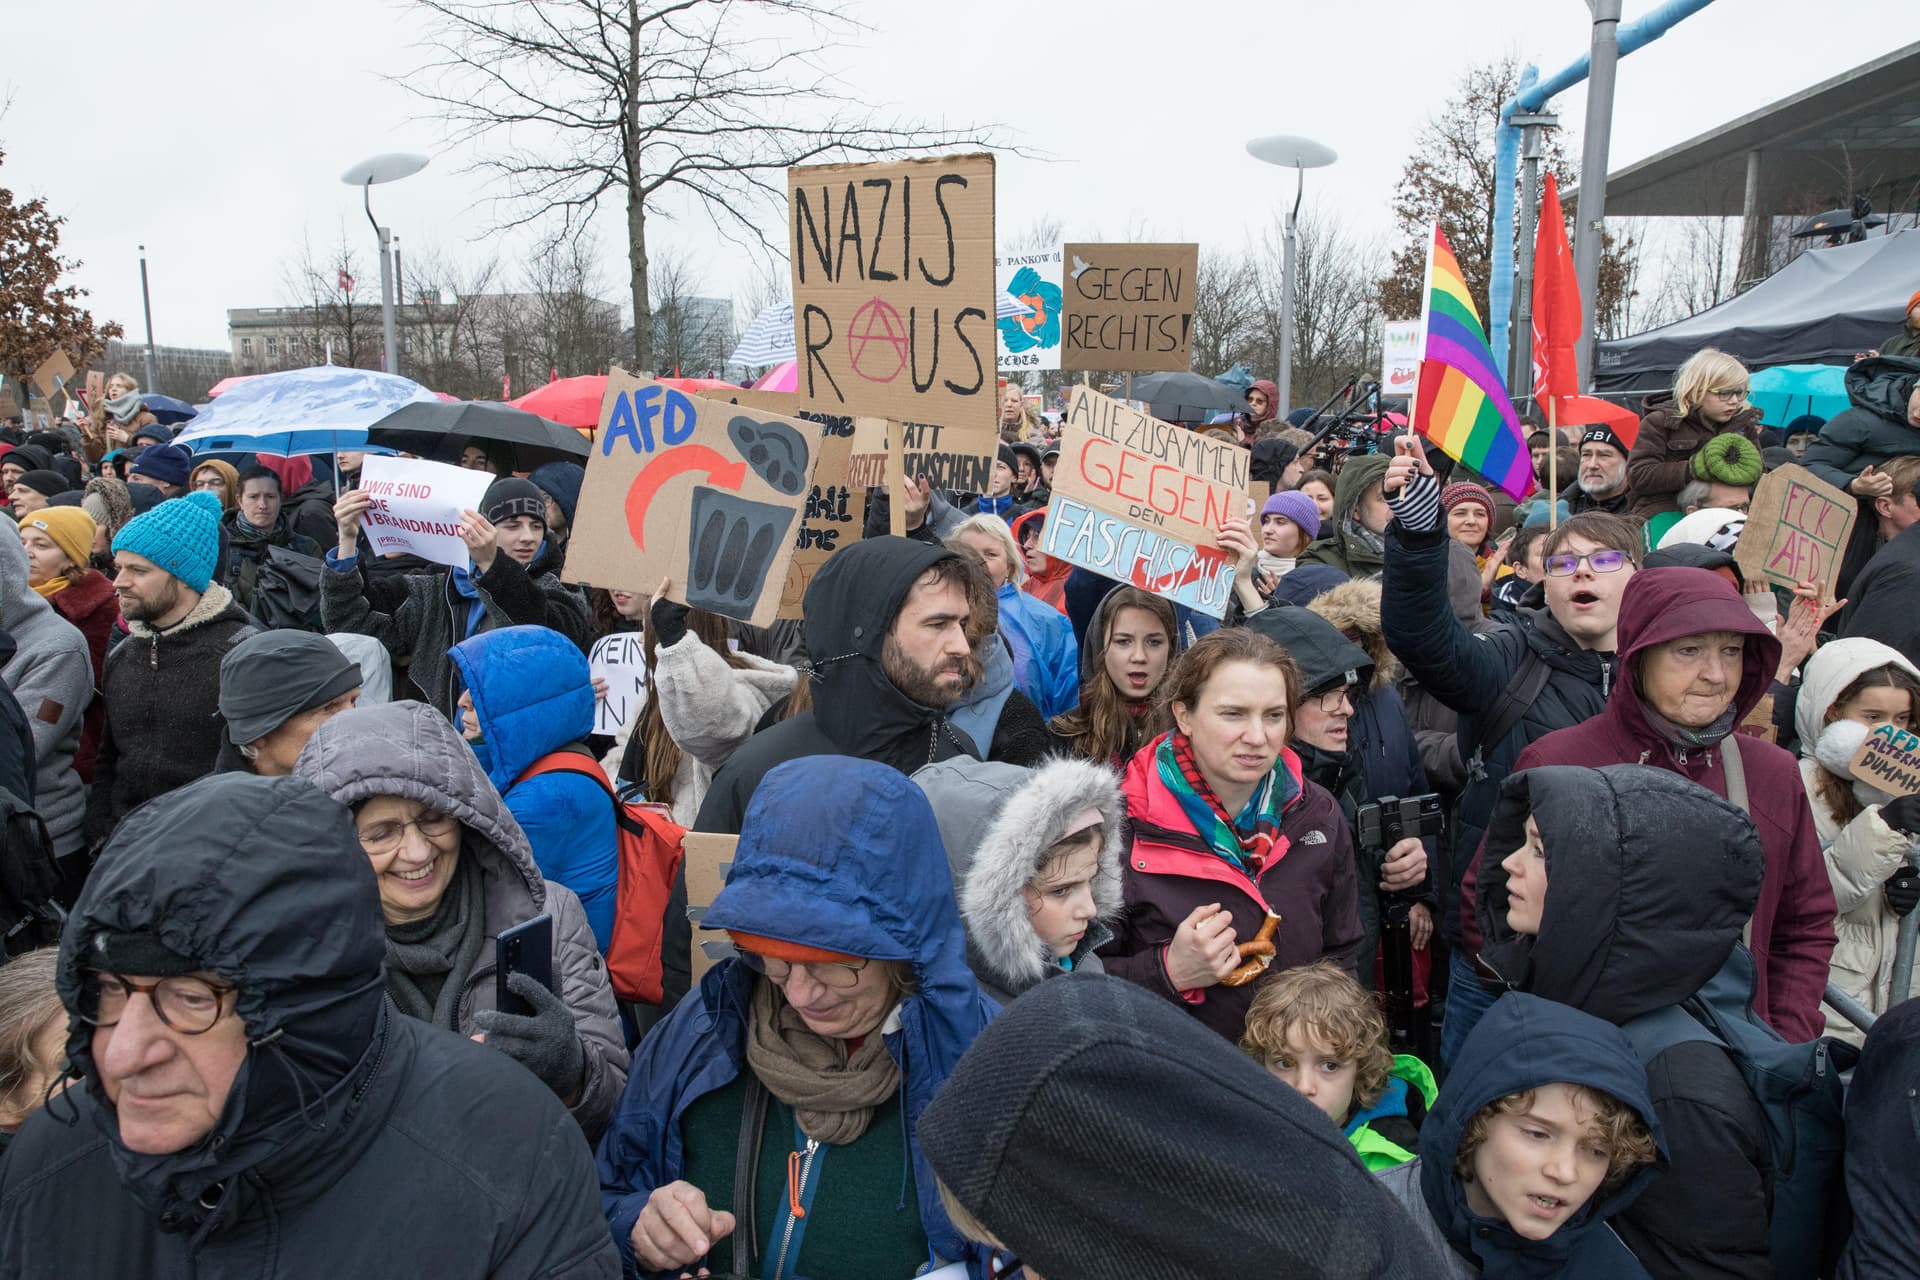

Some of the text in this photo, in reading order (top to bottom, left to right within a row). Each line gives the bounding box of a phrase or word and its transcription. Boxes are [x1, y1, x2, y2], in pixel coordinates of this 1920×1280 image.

[796, 174, 968, 288] NAZIS
[1008, 254, 1050, 265] PANKOW
[1076, 267, 1182, 302] GEGEN
[803, 296, 986, 403] RAUS
[1067, 313, 1192, 352] RECHTS!
[602, 385, 697, 456] AFD
[1071, 391, 1248, 490] ALLE ZUSAMMEN
[1583, 430, 1612, 442] FBI
[368, 480, 431, 499] WIR SIND
[368, 498, 390, 512] DIE
[1080, 438, 1230, 531] GEGEN
[1128, 504, 1164, 526] DEN
[1784, 483, 1832, 538] FCK
[1048, 497, 1236, 610] FASCHISMUS
[1768, 530, 1821, 583] AFD
[1874, 725, 1919, 752] AFD
